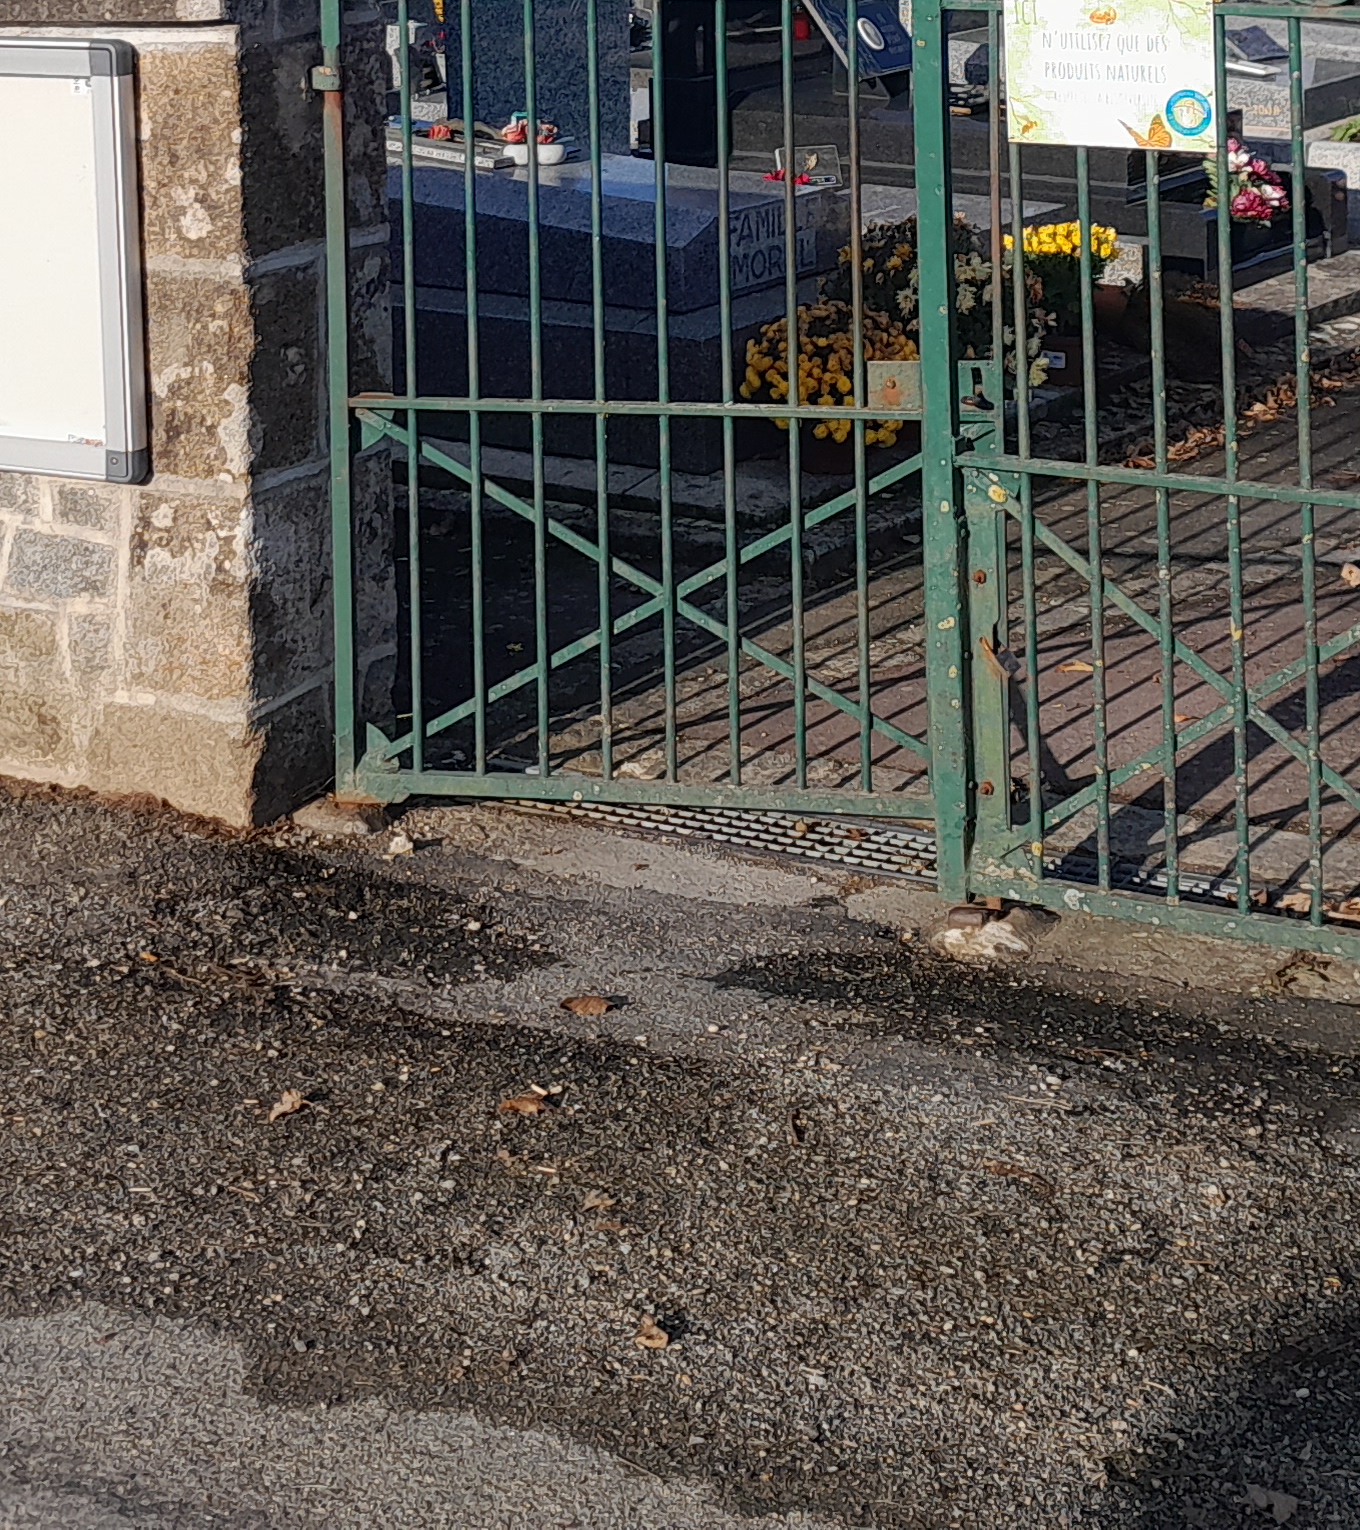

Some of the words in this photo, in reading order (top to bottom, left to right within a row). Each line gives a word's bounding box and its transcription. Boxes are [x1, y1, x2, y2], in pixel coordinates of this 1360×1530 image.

[1013, 0, 1038, 26] ICI
[1042, 30, 1111, 52] N'UTILISEZ
[1117, 33, 1139, 56] QUE
[1146, 34, 1168, 54] DES
[1044, 61, 1101, 81] PRODUITS
[1106, 64, 1167, 84] NATURELS
[730, 238, 814, 286] MORL
